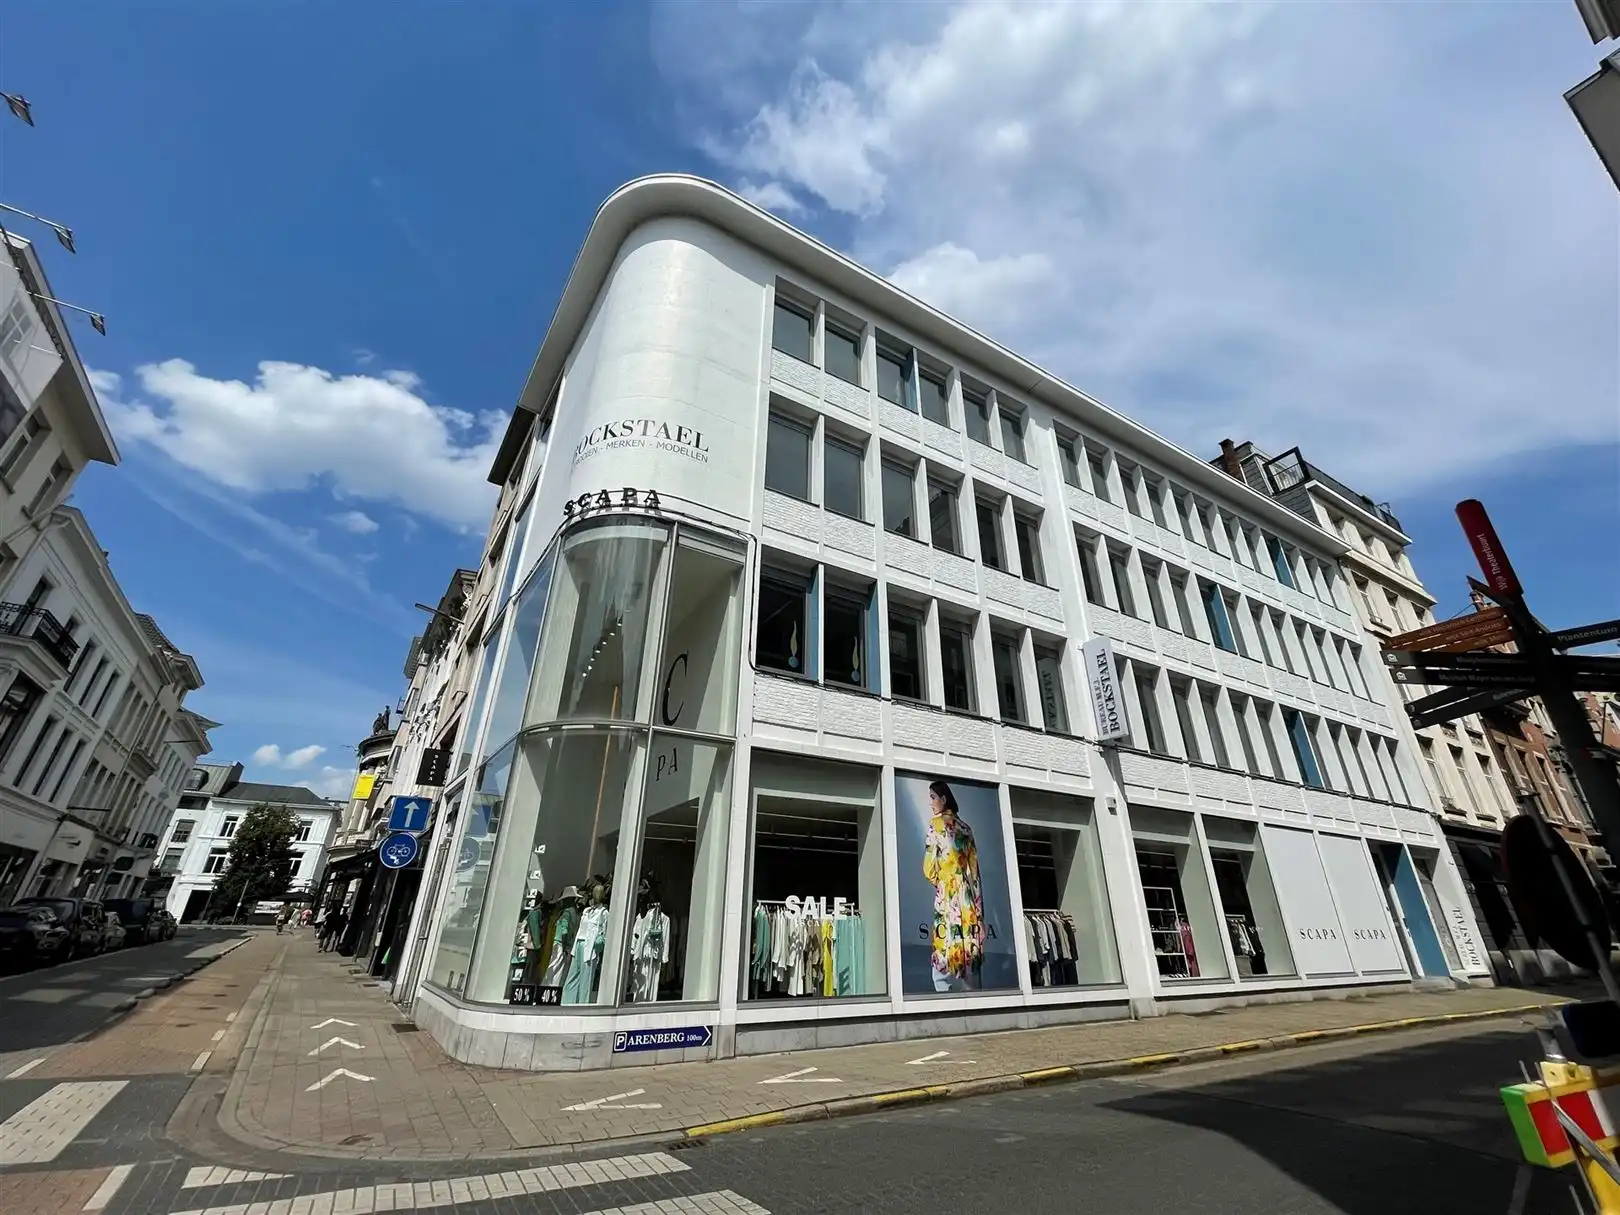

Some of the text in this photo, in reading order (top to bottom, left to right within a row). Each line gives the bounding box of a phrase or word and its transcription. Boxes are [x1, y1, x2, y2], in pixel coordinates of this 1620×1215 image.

[605, 439, 646, 450] MERKEN
[656, 440, 709, 463] MODELLEN
[563, 487, 661, 516] SCAPA
[1096, 648, 1120, 733] BOCKSTAEL
[785, 895, 847, 921] SALE
[918, 922, 998, 940] SCAPA
[1300, 927, 1337, 940] SCAPA
[1353, 929, 1386, 940] SCAPA
[1452, 906, 1481, 966] BOCKSTAEL
[513, 987, 523, 1002] 50
[541, 989, 551, 1003] 40
[627, 1031, 685, 1046] ARENBERG
